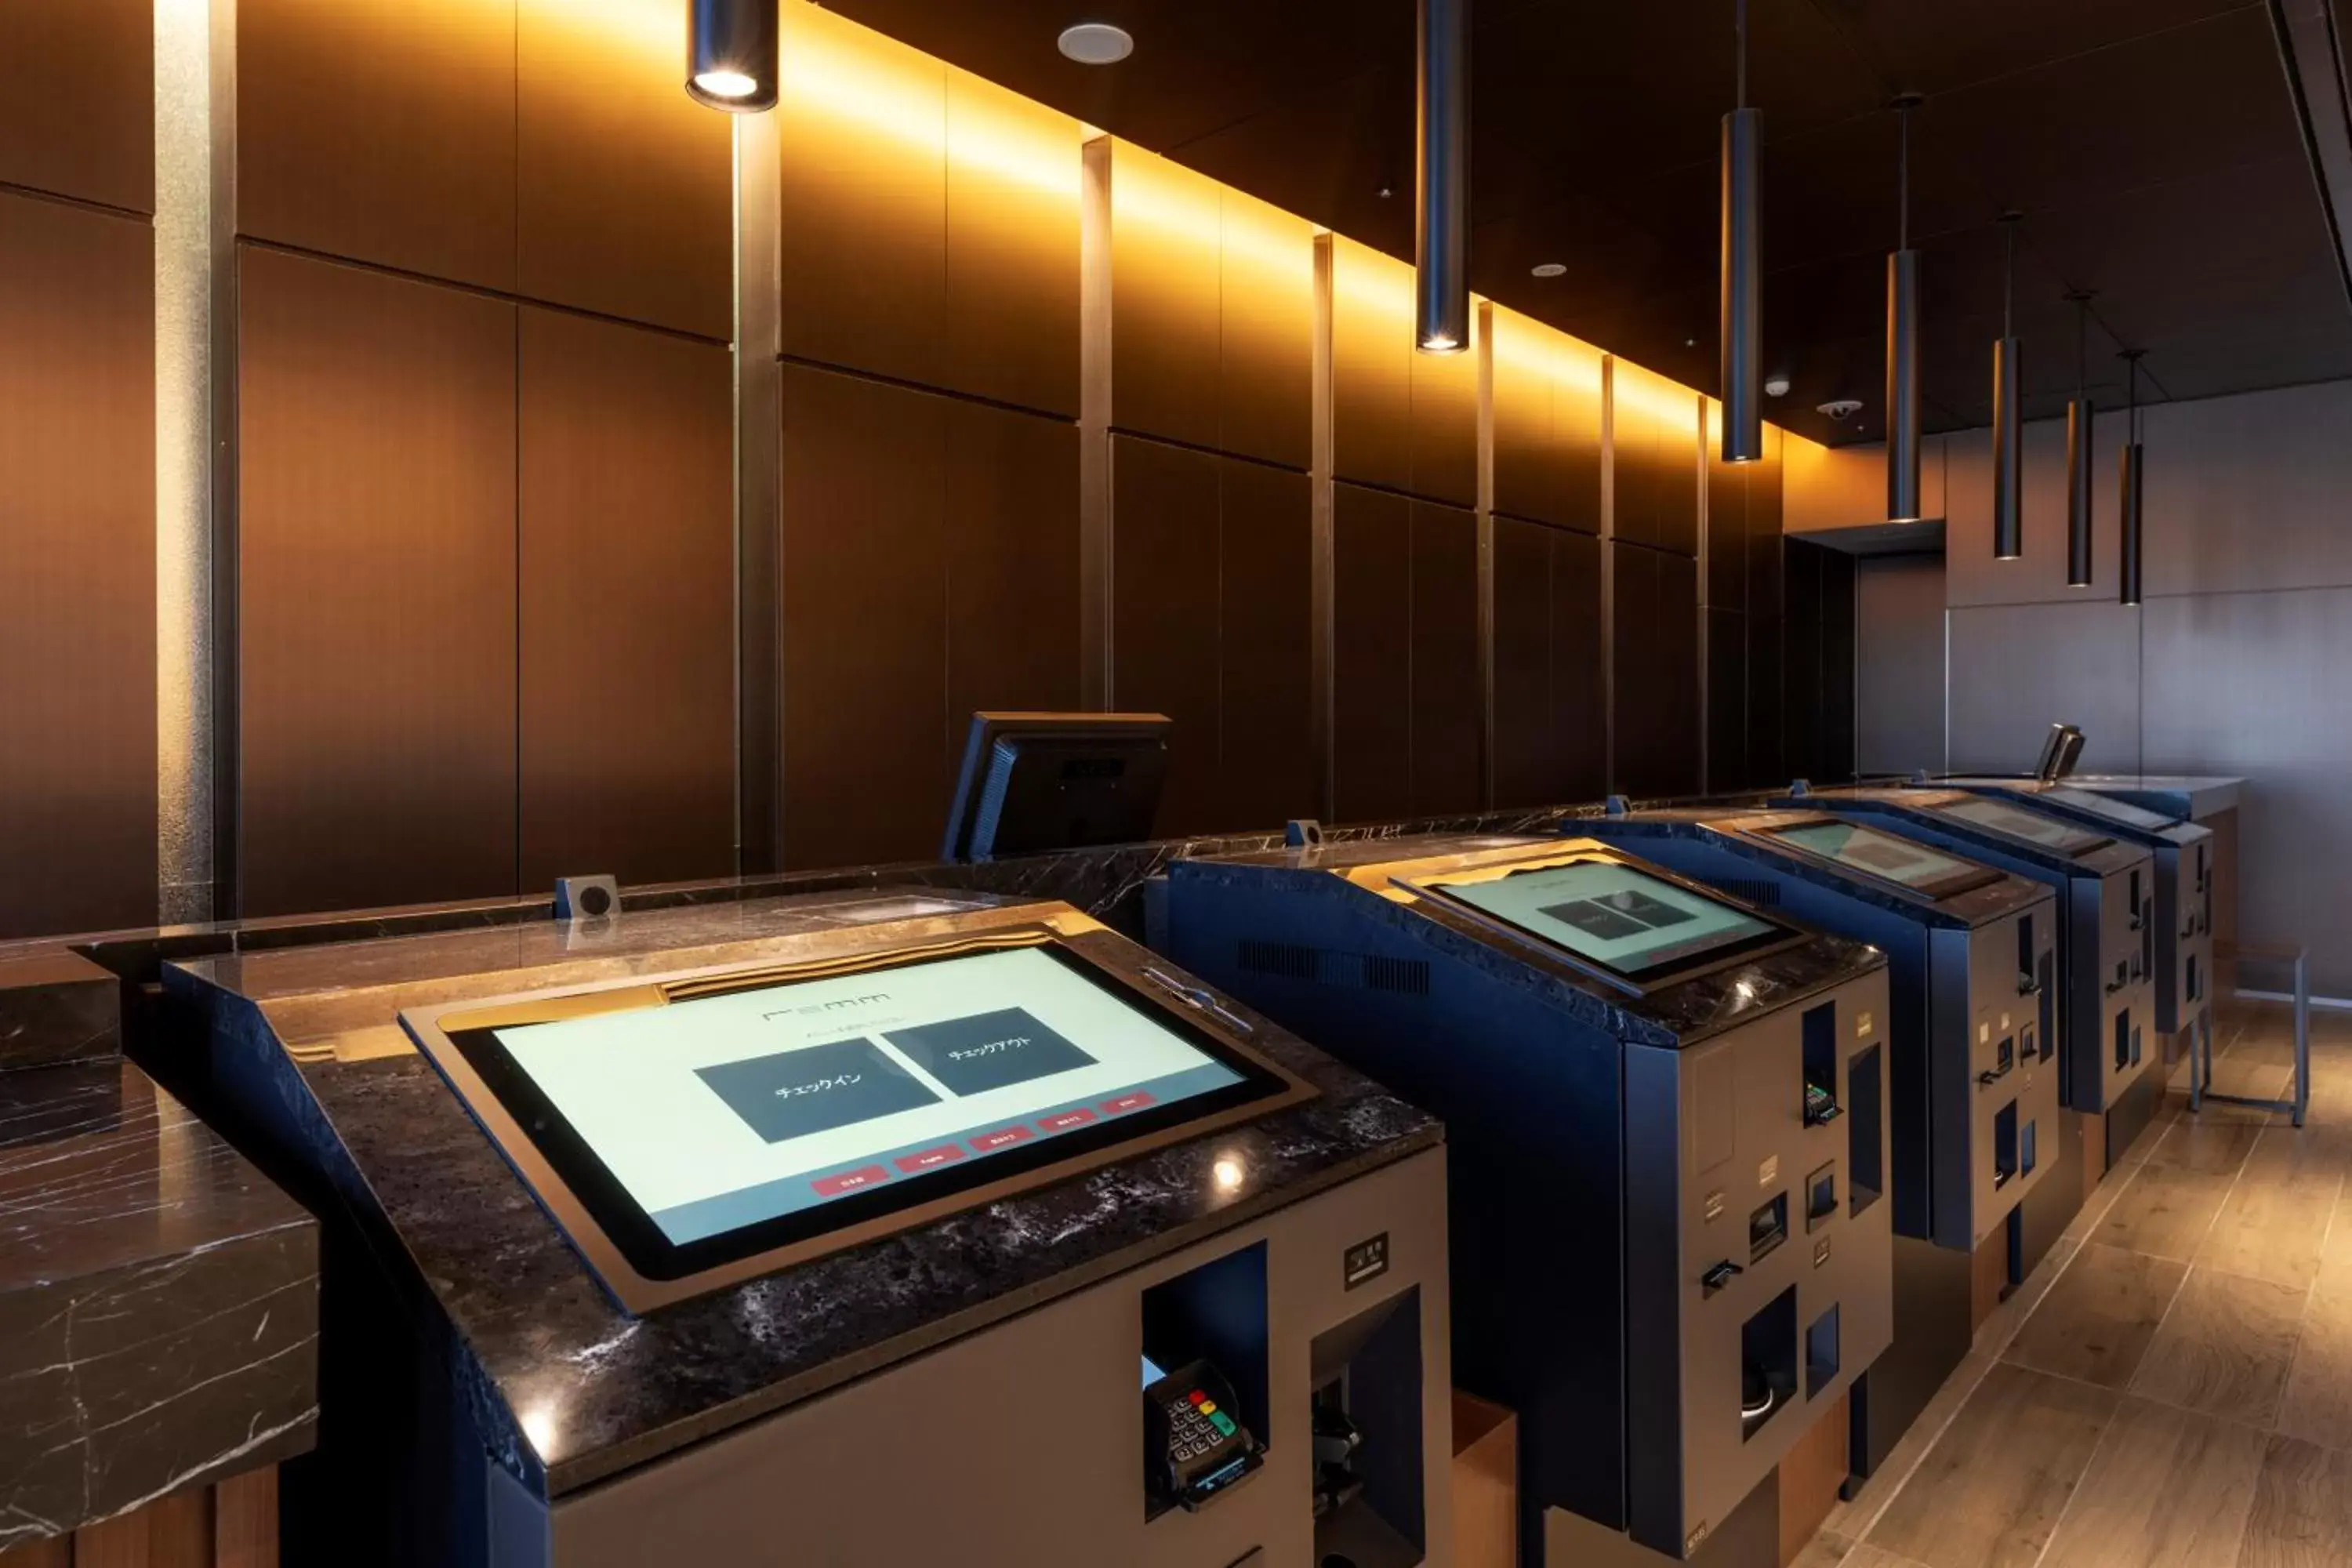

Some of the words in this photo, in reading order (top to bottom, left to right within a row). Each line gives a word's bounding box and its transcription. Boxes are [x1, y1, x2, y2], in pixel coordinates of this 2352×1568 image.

[948, 1036, 1031, 1062] チェックアウト
[775, 1073, 861, 1098] チェックイン
